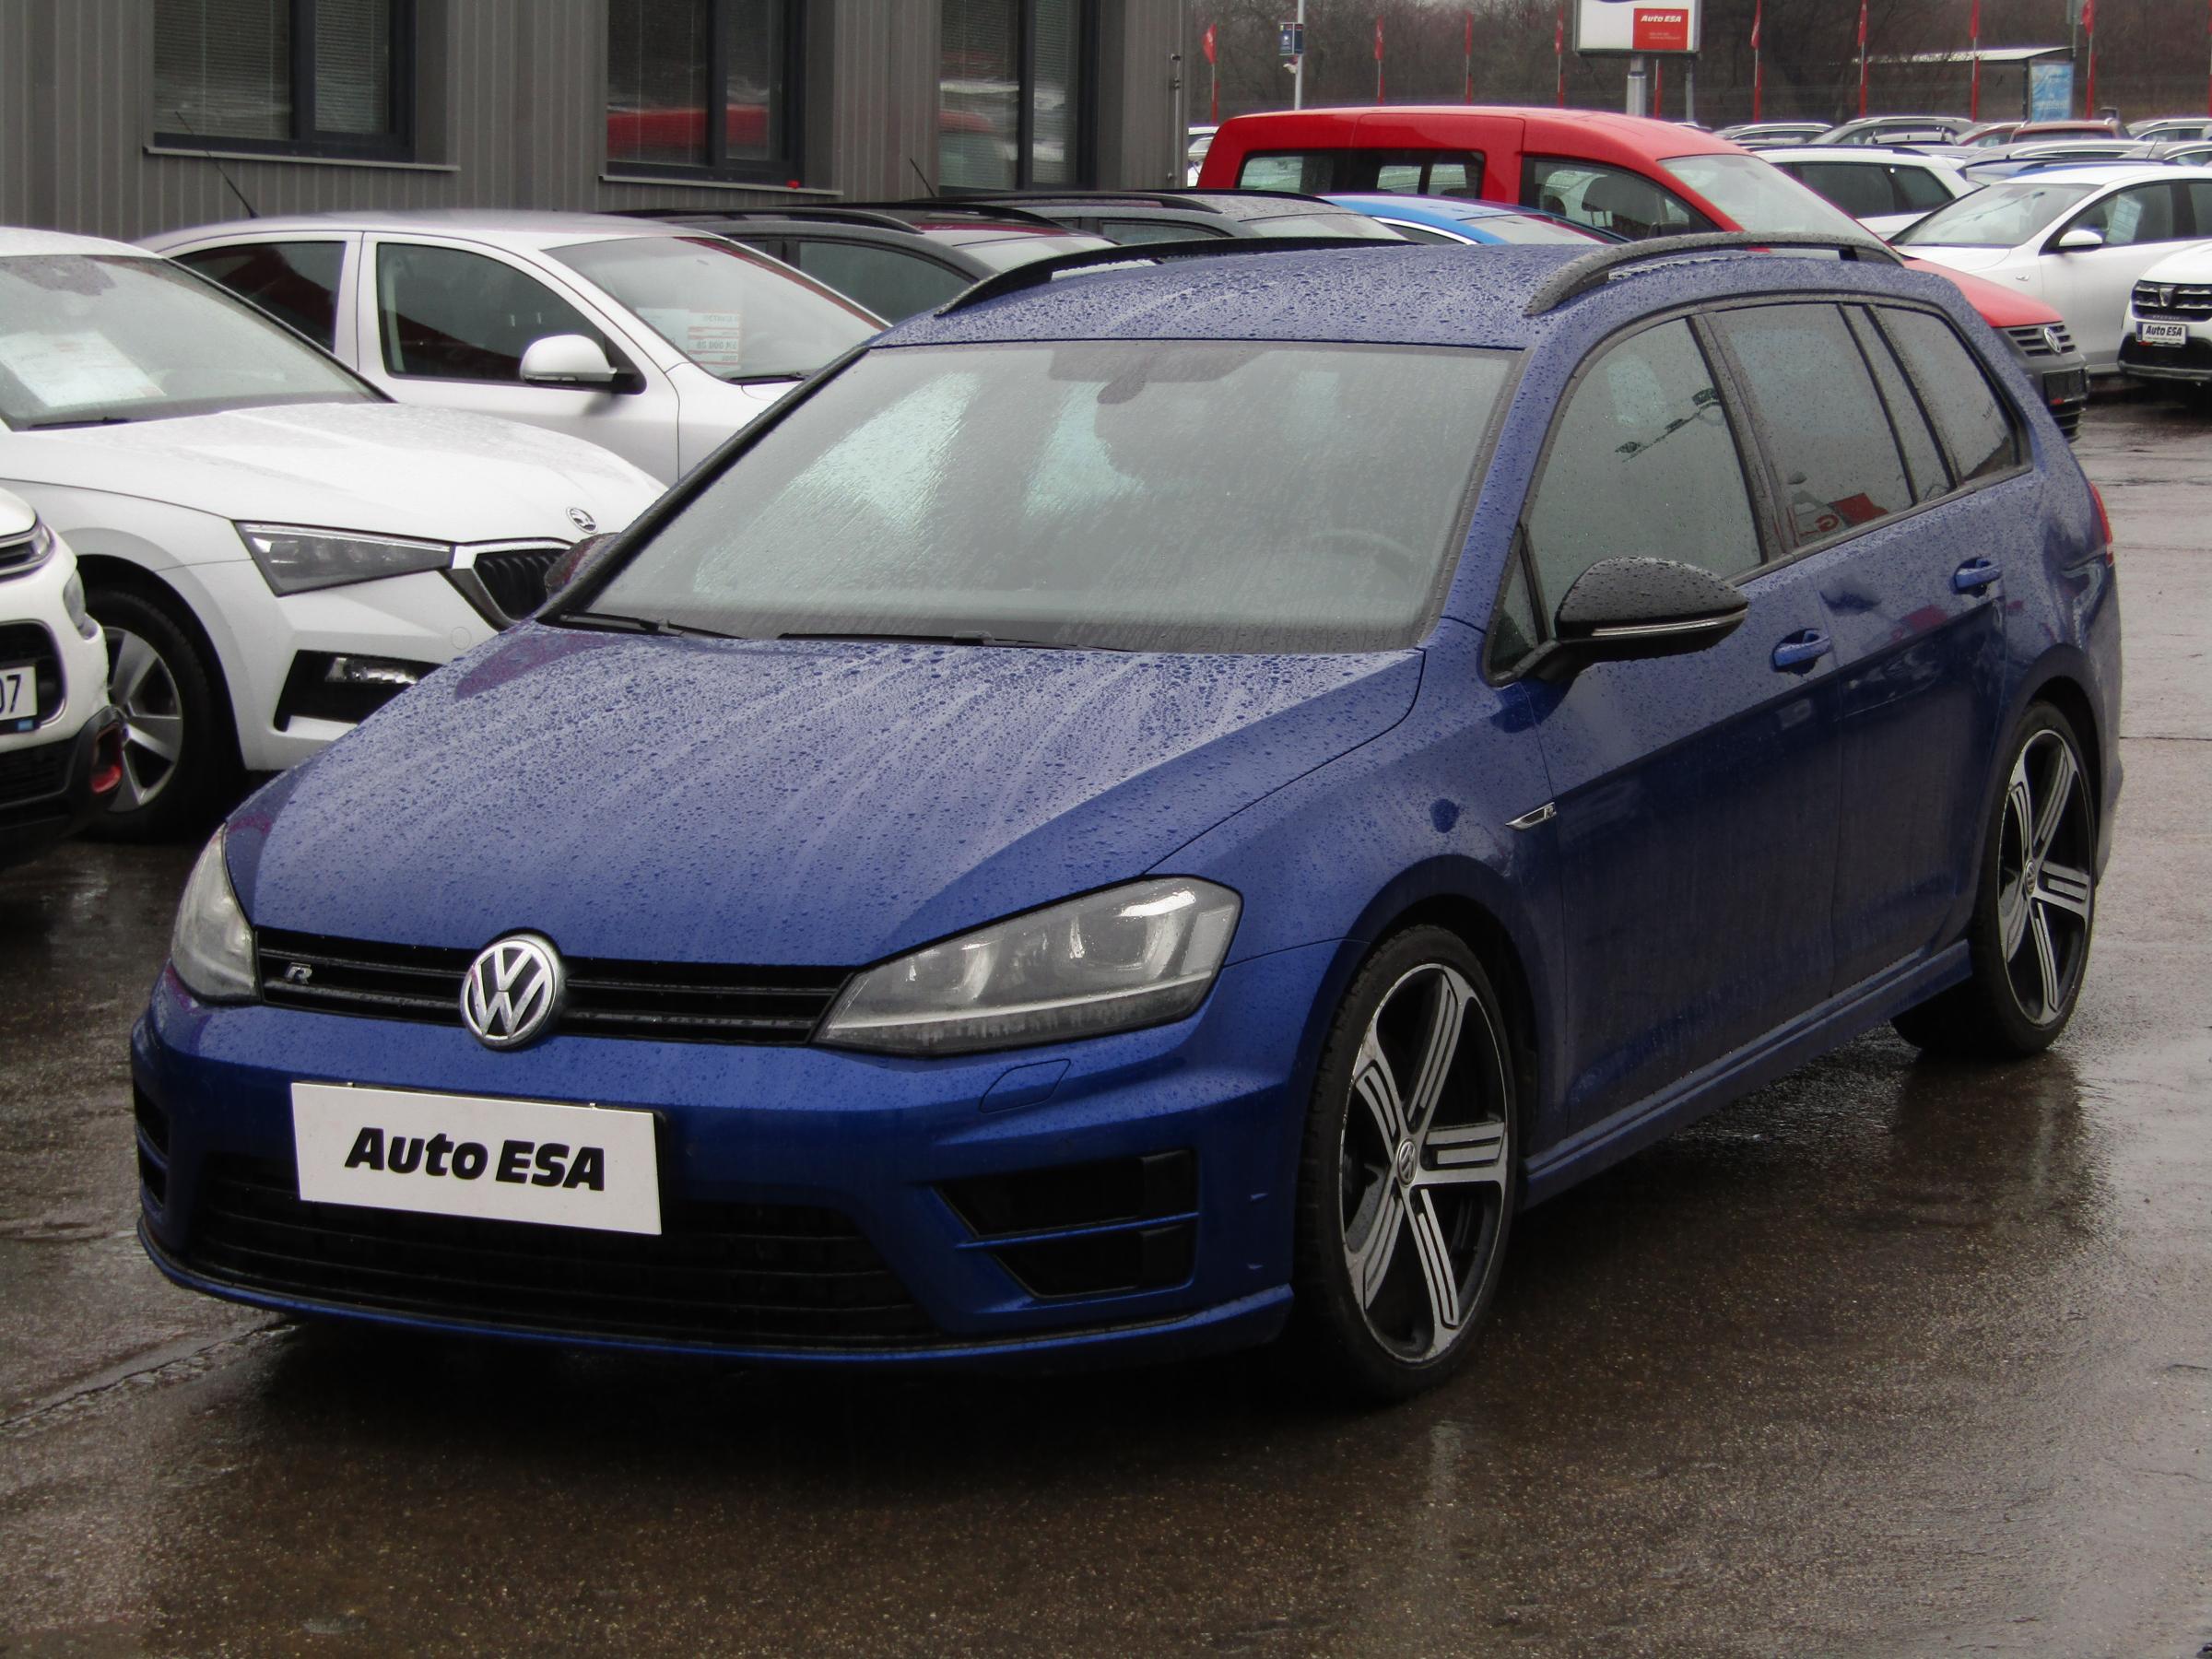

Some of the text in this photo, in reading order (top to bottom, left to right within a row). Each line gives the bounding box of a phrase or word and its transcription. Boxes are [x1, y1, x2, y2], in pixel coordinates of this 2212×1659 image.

[1664, 15, 1682, 23] ESA
[2146, 325, 2183, 336] Auto ESA
[284, 962, 313, 985] R
[345, 1126, 605, 1192] Auto ESA
